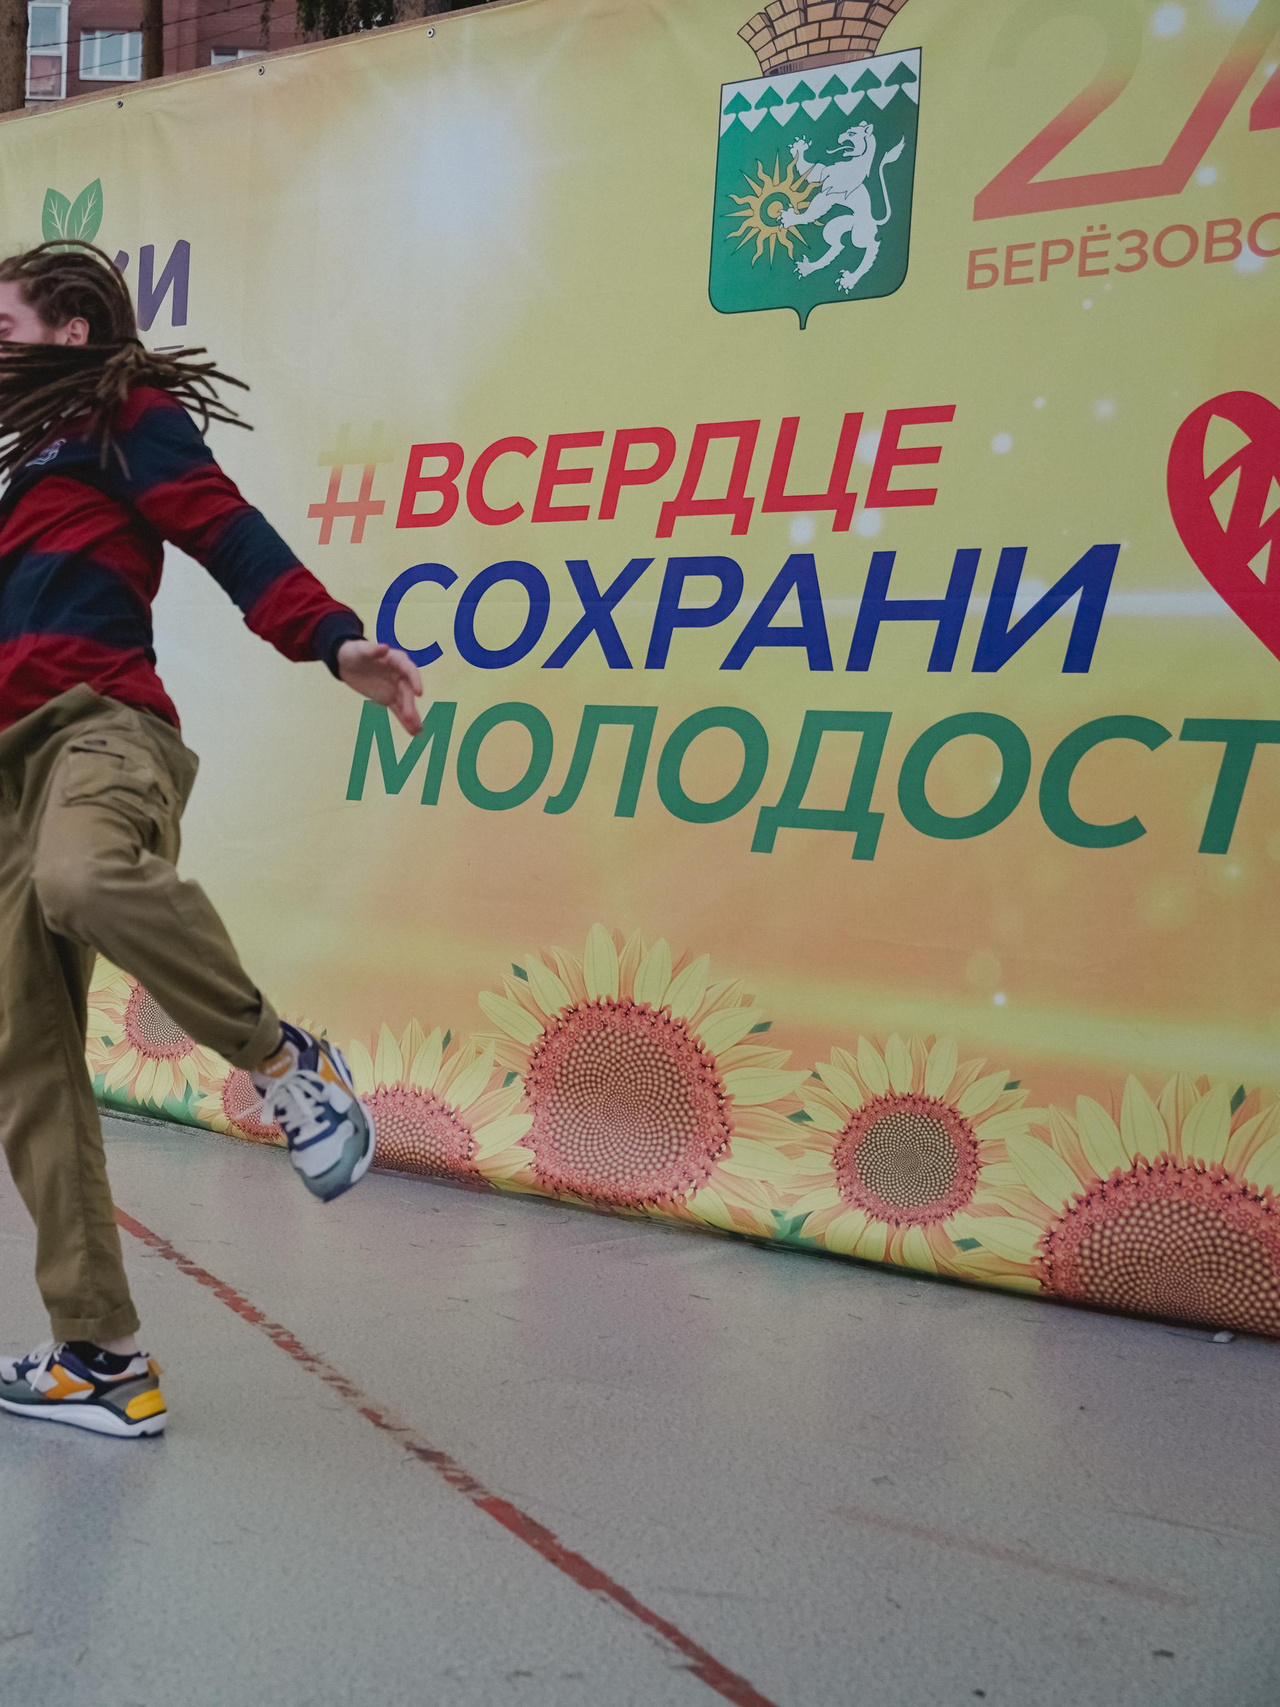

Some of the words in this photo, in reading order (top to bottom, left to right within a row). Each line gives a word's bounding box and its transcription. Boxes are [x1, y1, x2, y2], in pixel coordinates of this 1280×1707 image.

[307, 404, 956, 545] #ВСЕРДЦЕ
[376, 544, 1120, 673] СОХРАНИ
[345, 699, 1280, 861] МОЛОДОСТ
